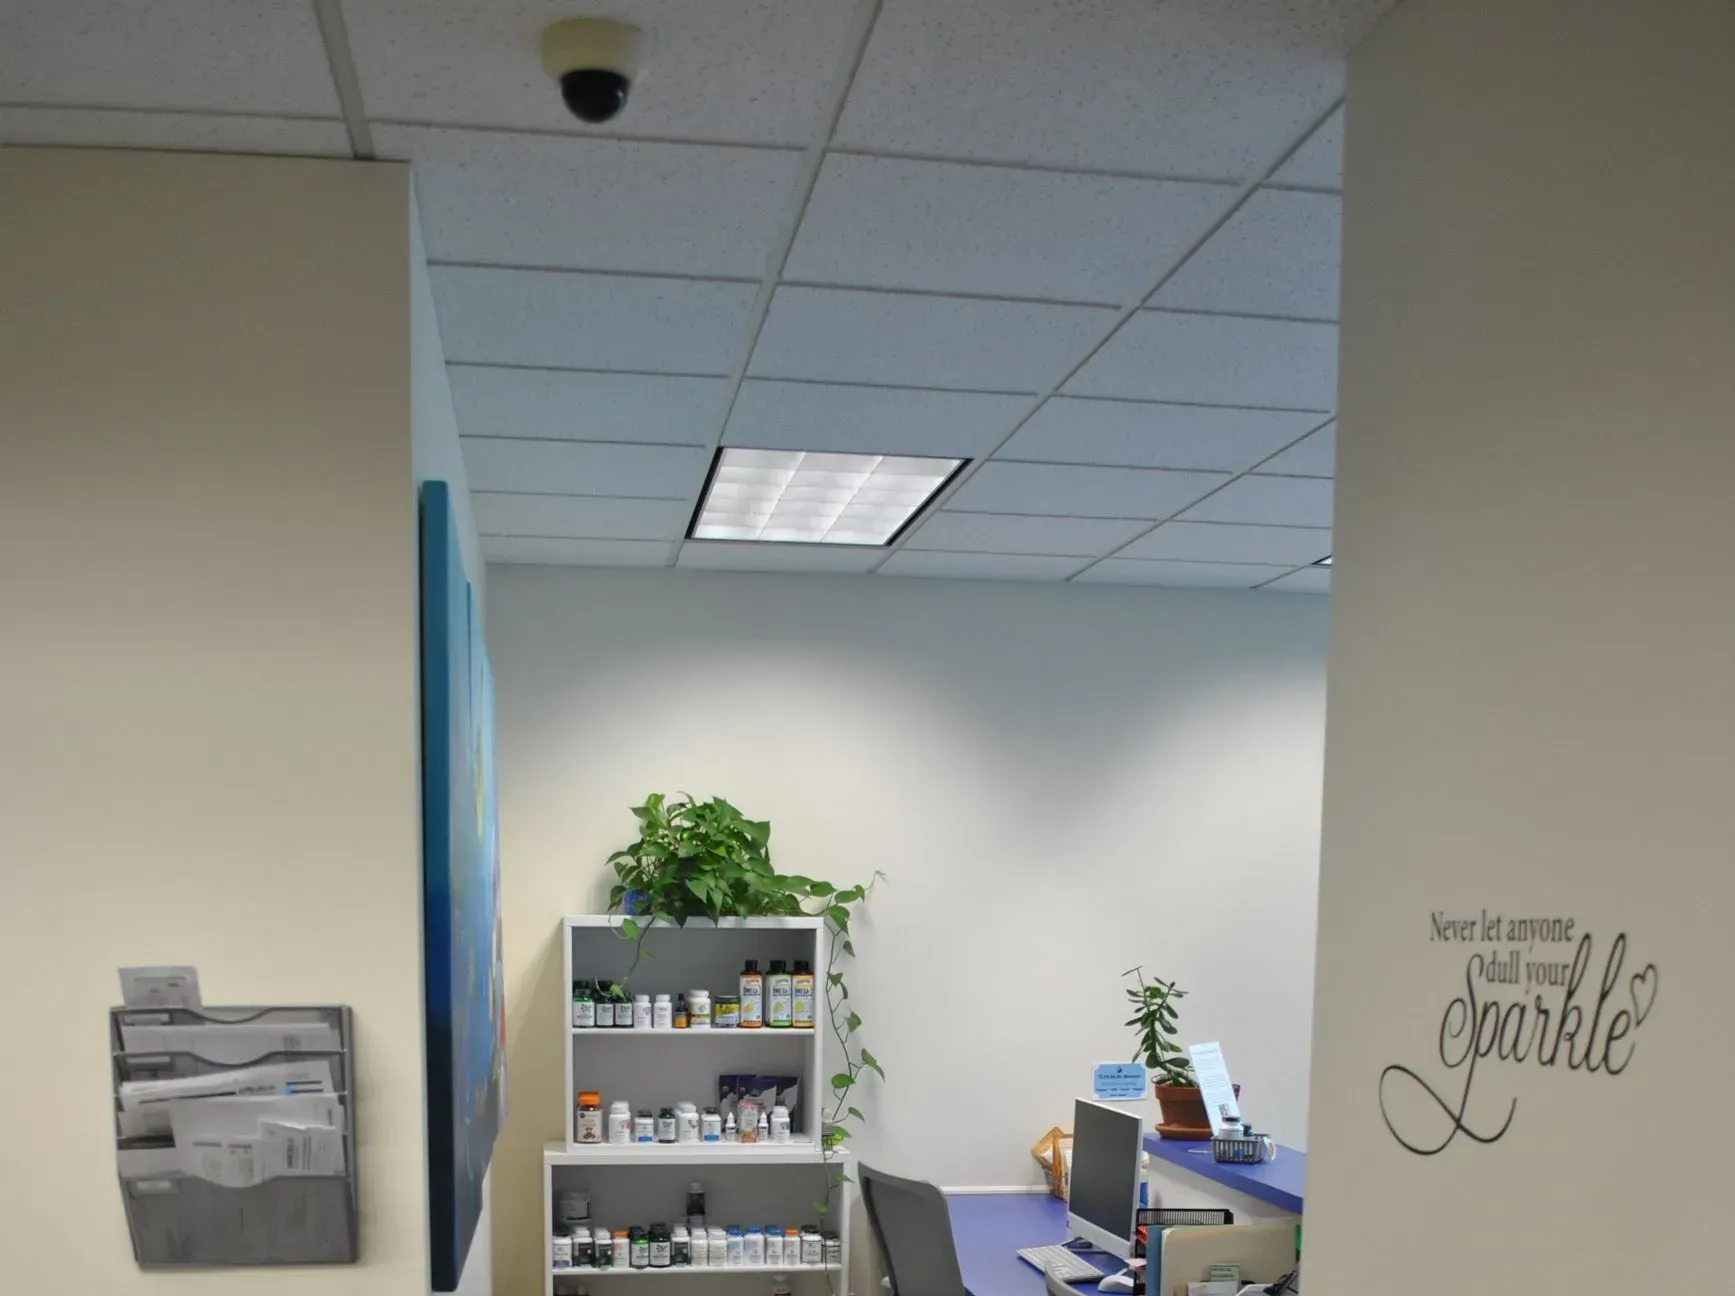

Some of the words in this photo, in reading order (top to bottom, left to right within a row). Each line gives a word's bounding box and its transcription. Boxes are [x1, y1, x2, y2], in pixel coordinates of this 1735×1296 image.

[1430, 911, 1476, 942] Never
[1481, 908, 1501, 942] let
[1506, 917, 1575, 953] anyone
[1486, 950, 1520, 984] dull
[1525, 961, 1570, 995] your
[1379, 932, 1636, 1155] Sparkle
